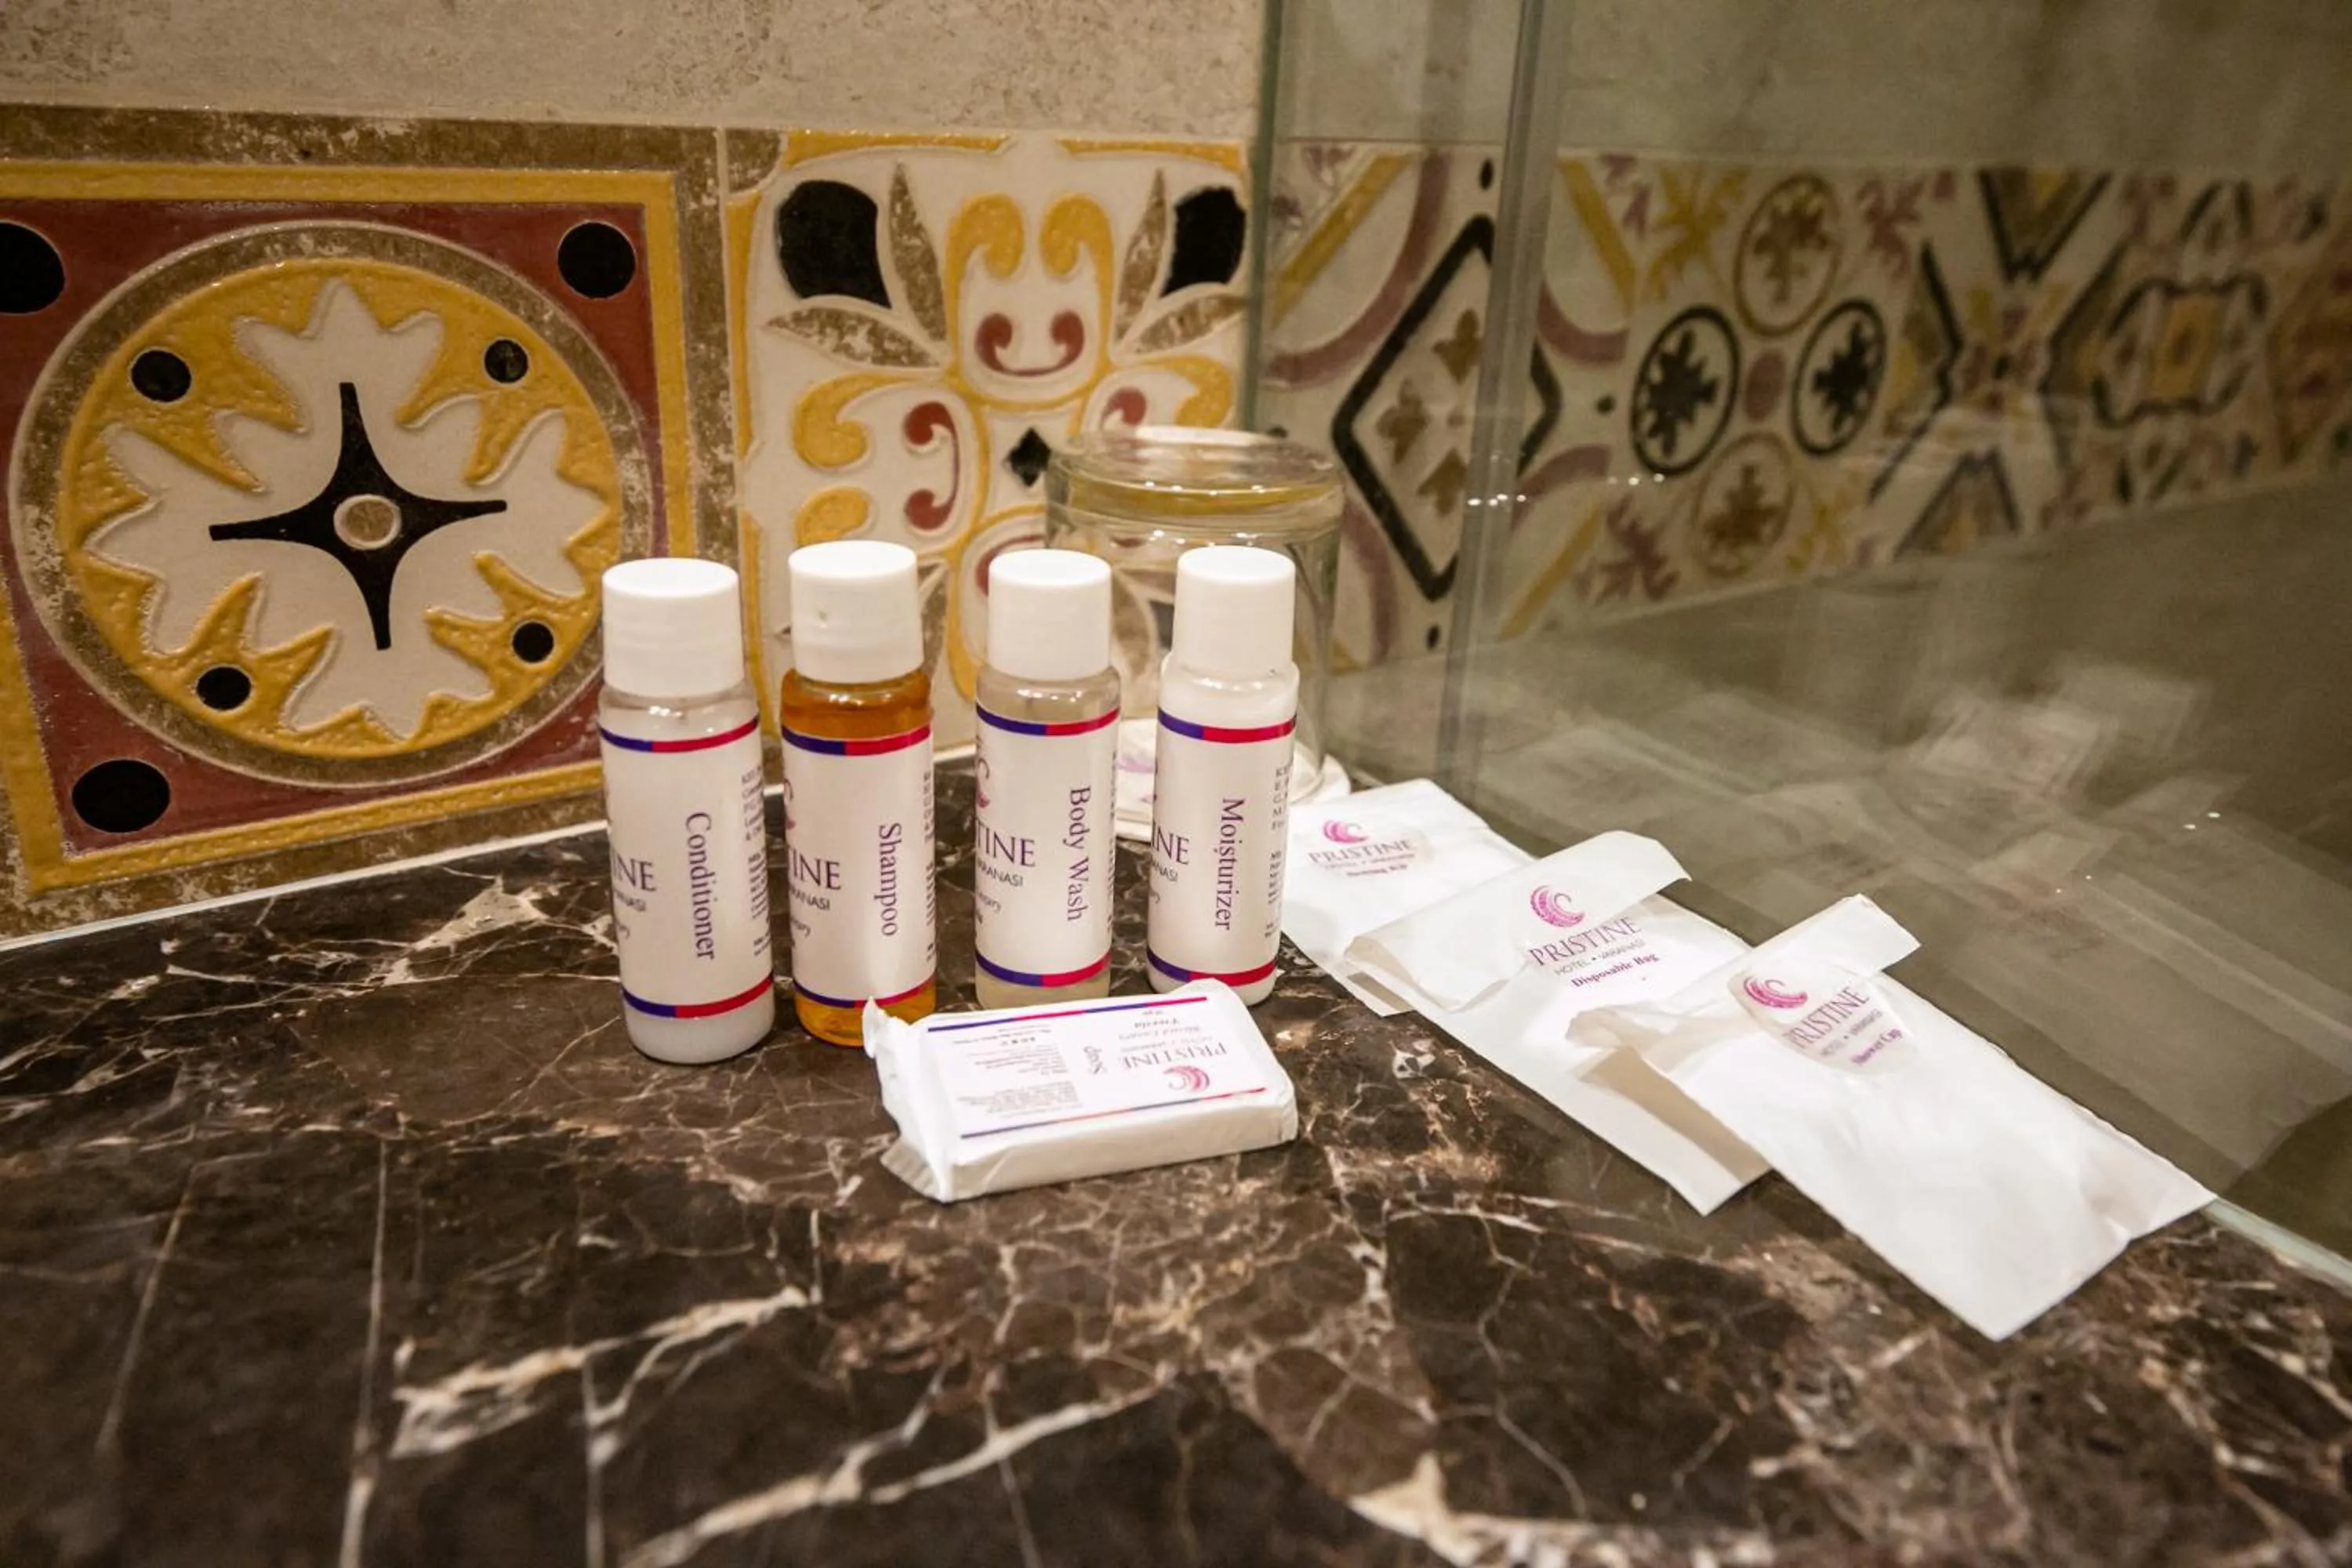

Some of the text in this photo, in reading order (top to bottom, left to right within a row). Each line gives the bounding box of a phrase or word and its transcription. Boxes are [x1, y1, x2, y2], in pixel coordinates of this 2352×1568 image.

[873, 822, 902, 937] Shampoo
[1062, 786, 1091, 922] Body Wash
[1213, 796, 1246, 931] Moisturizer
[1307, 840, 1417, 864] PRISTINE
[685, 811, 719, 960] Conditioner
[1528, 916, 1642, 967] PRISTINE
[1570, 962, 1634, 988] Disposable
[1781, 985, 1871, 1050] PRISTINE
[1119, 1041, 1228, 1069] PRISTINE
